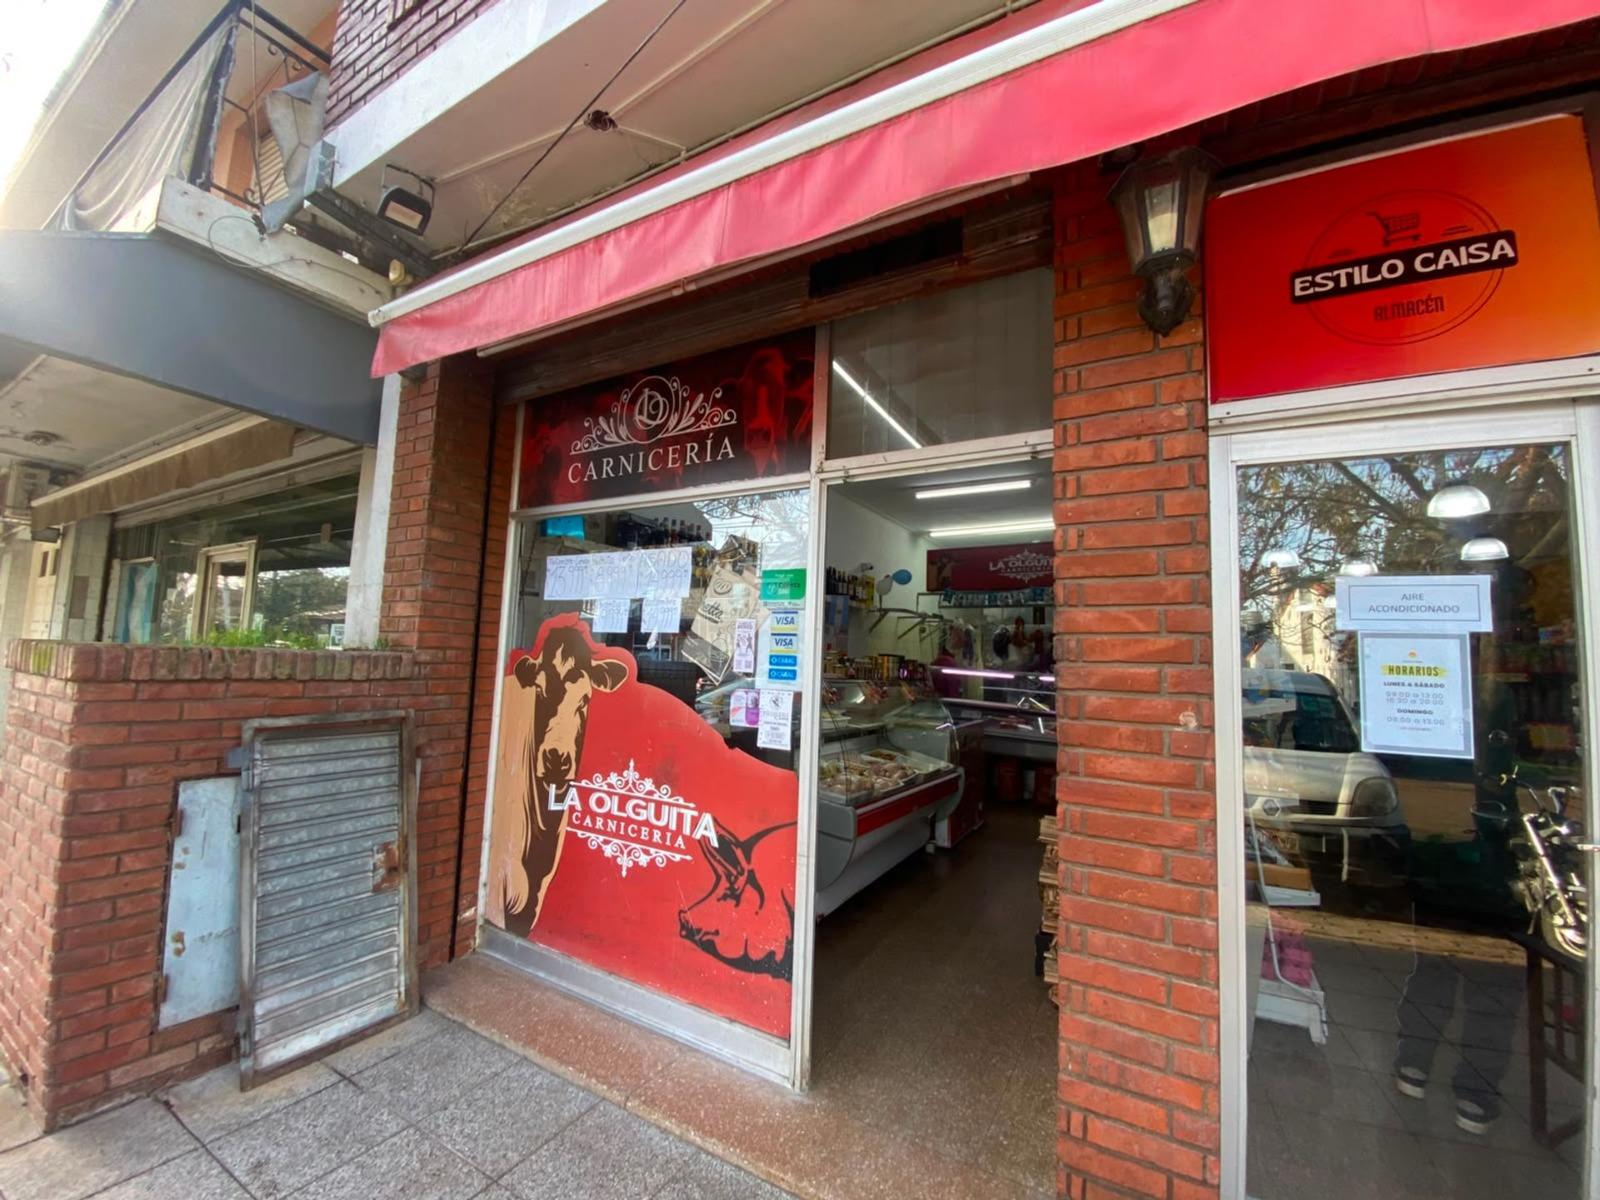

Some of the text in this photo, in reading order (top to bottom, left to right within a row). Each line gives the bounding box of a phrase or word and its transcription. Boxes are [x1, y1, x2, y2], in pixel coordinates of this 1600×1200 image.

[1294, 239, 1516, 297] ESTILO CAISA
[568, 432, 735, 484] CARNICERÍA
[989, 561, 1006, 571] LA
[1401, 593, 1425, 601] AIRE
[1368, 604, 1460, 614] ACONDICIONADO
[775, 616, 795, 625] VISA
[774, 638, 793, 647] VISA
[1388, 664, 1439, 677] HORARIOS
[548, 783, 719, 848] LA OLGUITA
[572, 812, 686, 850] CARNICERIA
